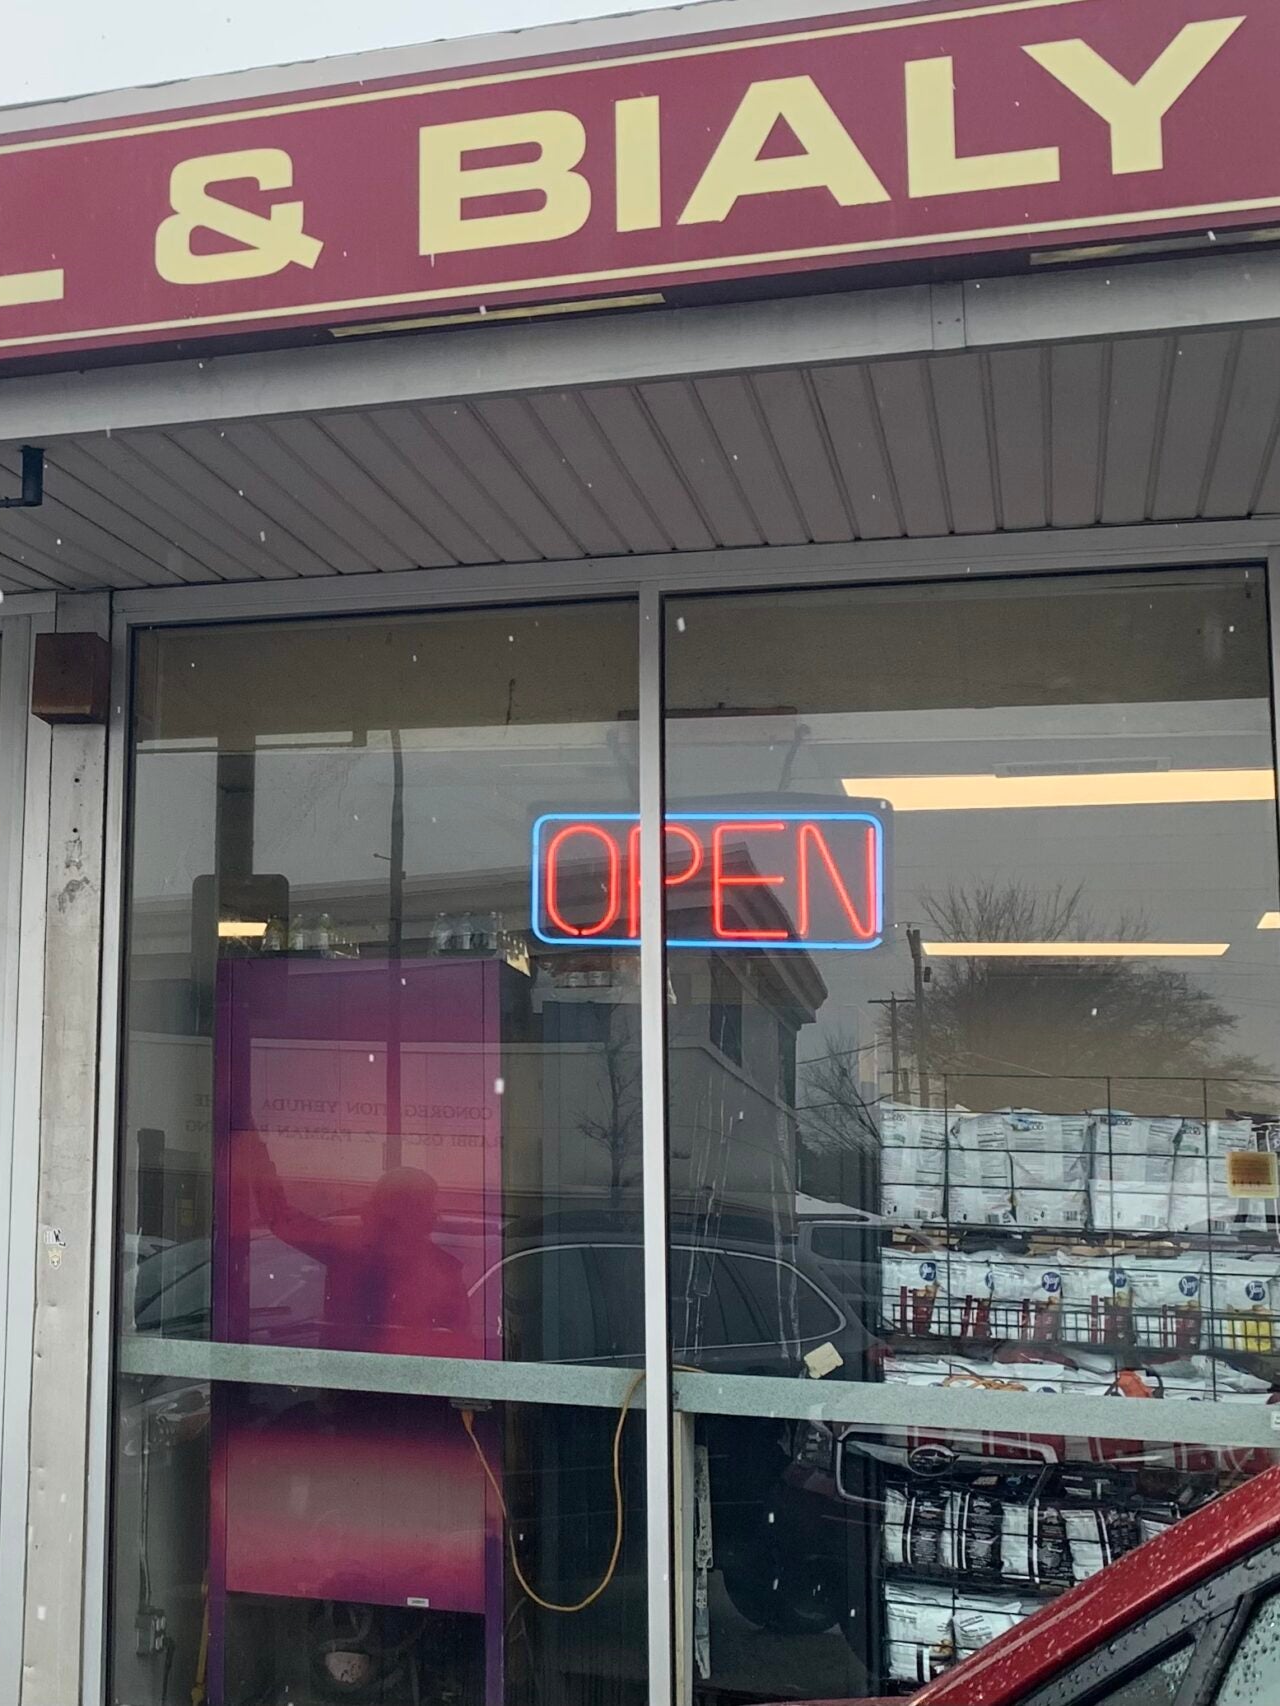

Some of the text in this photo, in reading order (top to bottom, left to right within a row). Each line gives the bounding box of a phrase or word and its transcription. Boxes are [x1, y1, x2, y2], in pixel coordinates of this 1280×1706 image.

[154, 148, 324, 286] &
[418, 15, 1248, 257] BIALY
[544, 821, 876, 940] OPEN
